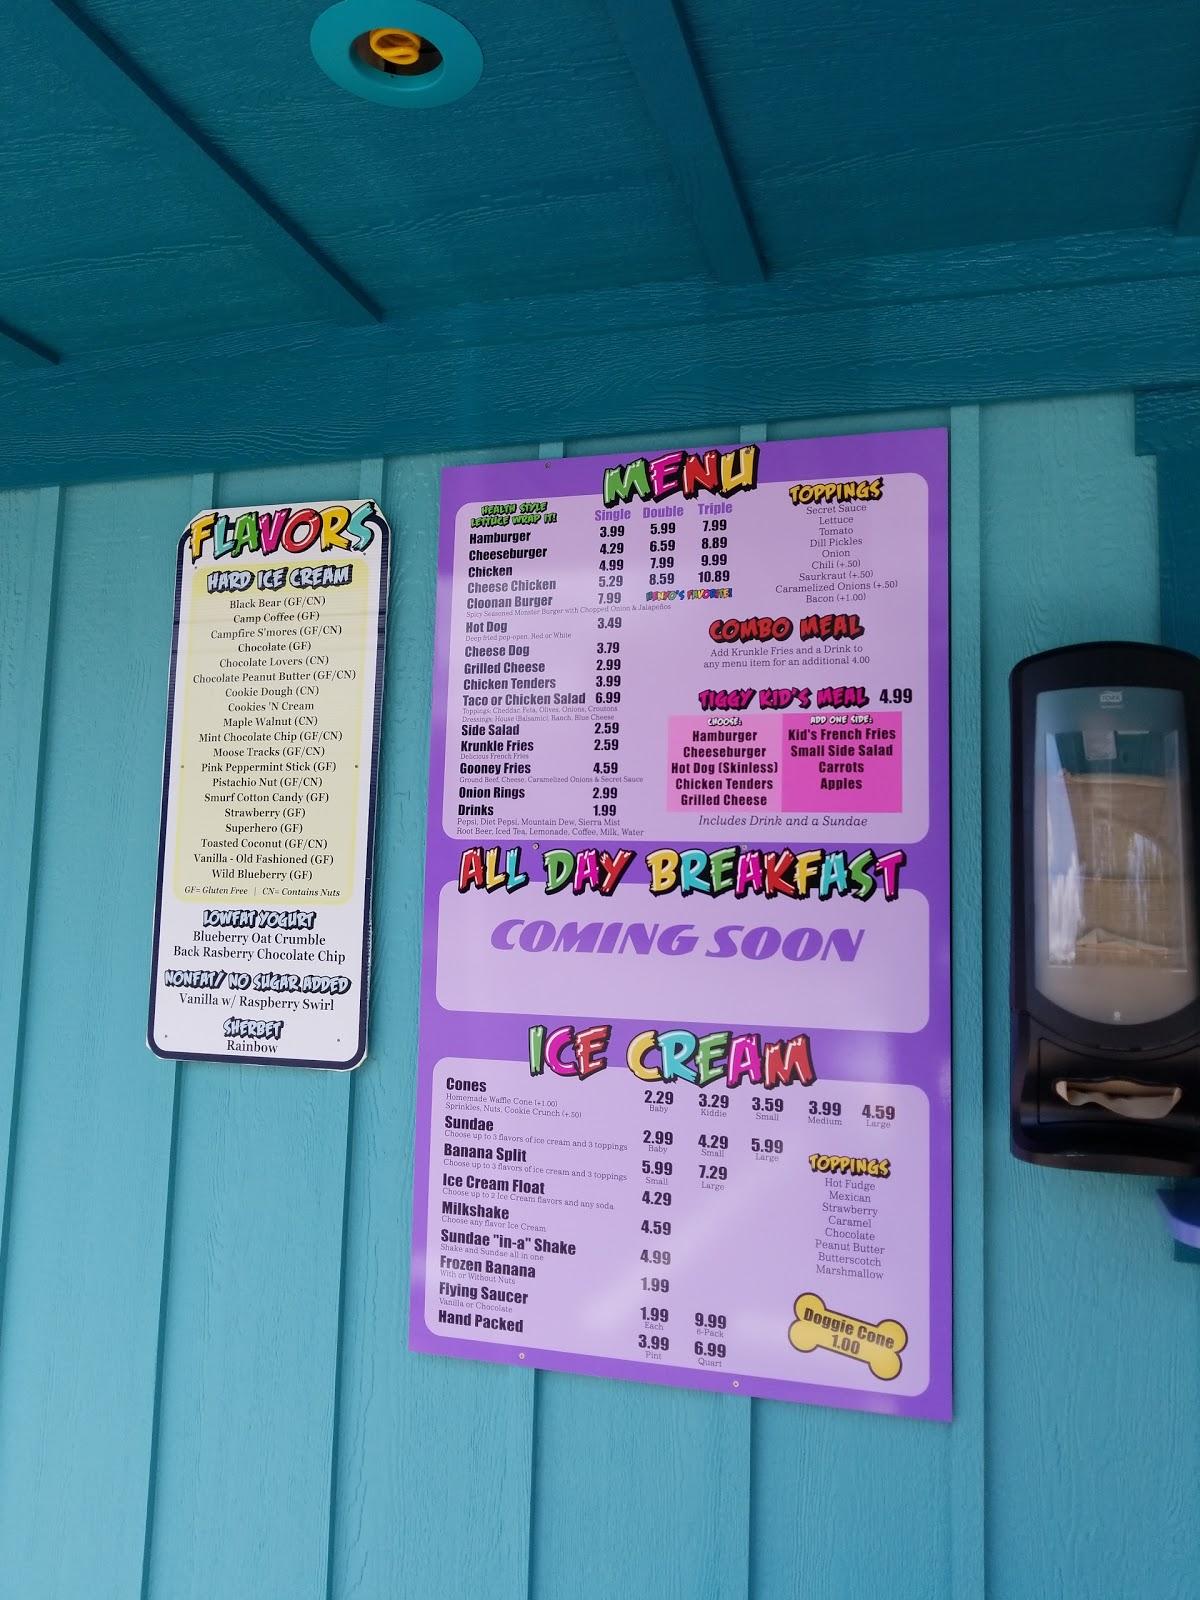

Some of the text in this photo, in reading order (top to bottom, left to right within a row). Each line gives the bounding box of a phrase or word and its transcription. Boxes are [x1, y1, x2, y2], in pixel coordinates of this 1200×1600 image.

[603, 444, 760, 508] MENU
[789, 477, 884, 506] TOPPINGS
[481, 502, 548, 515] HEALTH STYLE
[595, 503, 732, 521] Single Double Triple
[806, 504, 867, 514] Secret Sauce
[470, 513, 557, 528] LETTUCE WRAP IT!
[819, 516, 853, 524] Lettuce
[190, 501, 377, 564] FLAVORS
[470, 520, 727, 544] Hamburger 3.99 5.99 7.99
[819, 527, 853, 535] Tomato
[469, 537, 727, 561] Cheeseburger 4.29 6.59 8.89
[810, 538, 862, 547] Dill Pickles
[822, 549, 850, 558] Onion
[207, 564, 353, 593] HARD ICE CREAM
[230, 596, 326, 608] Black Bear (GF/CN)
[234, 612, 320, 623] Camp Coffee (GF)
[709, 614, 865, 644] COMBO MEAL
[238, 642, 311, 652] Chocolate (GF)
[711, 649, 729, 657] Add
[731, 647, 769, 656] Krunkle
[771, 647, 793, 655] Fries
[824, 645, 850, 653] Drink
[225, 686, 319, 697] Cookie Dough (CN)
[698, 686, 912, 711] TIGGY KID'S MEAL 4.99
[223, 716, 318, 728] Maple Walnut (CN)
[461, 723, 619, 736] Side Salad 2.59
[692, 730, 757, 742] Hamburger
[788, 728, 896, 740] Kid's French Fries
[683, 747, 766, 758] Cheeseburger
[201, 762, 336, 773] Pink Peppermint Stick (GF)
[460, 763, 618, 775] Gooney Fries 4.59
[819, 762, 864, 773] Carrots
[820, 778, 862, 790] Apples
[225, 808, 305, 819] Strawberry (GF)
[458, 805, 616, 816] Drinks 1.99
[699, 816, 868, 827] Includes Drink and a Sundae
[212, 869, 312, 880] Wild Blueberry (GF)
[458, 845, 906, 902] ALL DAY BREAKFAST
[282, 888, 318, 896] Contains
[321, 889, 340, 897] Nuts
[203, 910, 316, 930] LOWFAT YOGURT
[193, 931, 325, 945] Blueberry Oat Crumble
[490, 919, 866, 962] COMING SOON
[174, 946, 345, 964] Back Rasberry Chocolate Chip
[164, 970, 352, 995] NONFAT/ NO SUGAR ADDED
[179, 993, 334, 1010] Vanilla w/ Raspberry Swirl
[223, 1017, 283, 1040] SHERBET
[227, 1040, 278, 1053] Rainbow
[528, 1024, 817, 1089] ICE CREAM
[446, 1078, 895, 1120] Cones 2.29 3.29 3.59 3.99 4.59
[445, 1116, 493, 1131] Sundae
[649, 1105, 891, 1129] Baby Kiddie Small Medium Large
[444, 1144, 727, 1180] Banana Split 5.99 7.29
[809, 1153, 891, 1178] TOPPINGS
[825, 1178, 875, 1191] Hot Fudge
[829, 1191, 871, 1203] Mexican
[822, 1203, 878, 1217] Strawberry
[442, 1201, 671, 1235] Milkshake 4.59
[816, 1265, 884, 1280] Marshmallow
[439, 1310, 726, 1357] Hand Packed 3.99 6.99
[804, 1308, 894, 1349] Doggie Cone
[831, 1335, 860, 1355] 1.00
